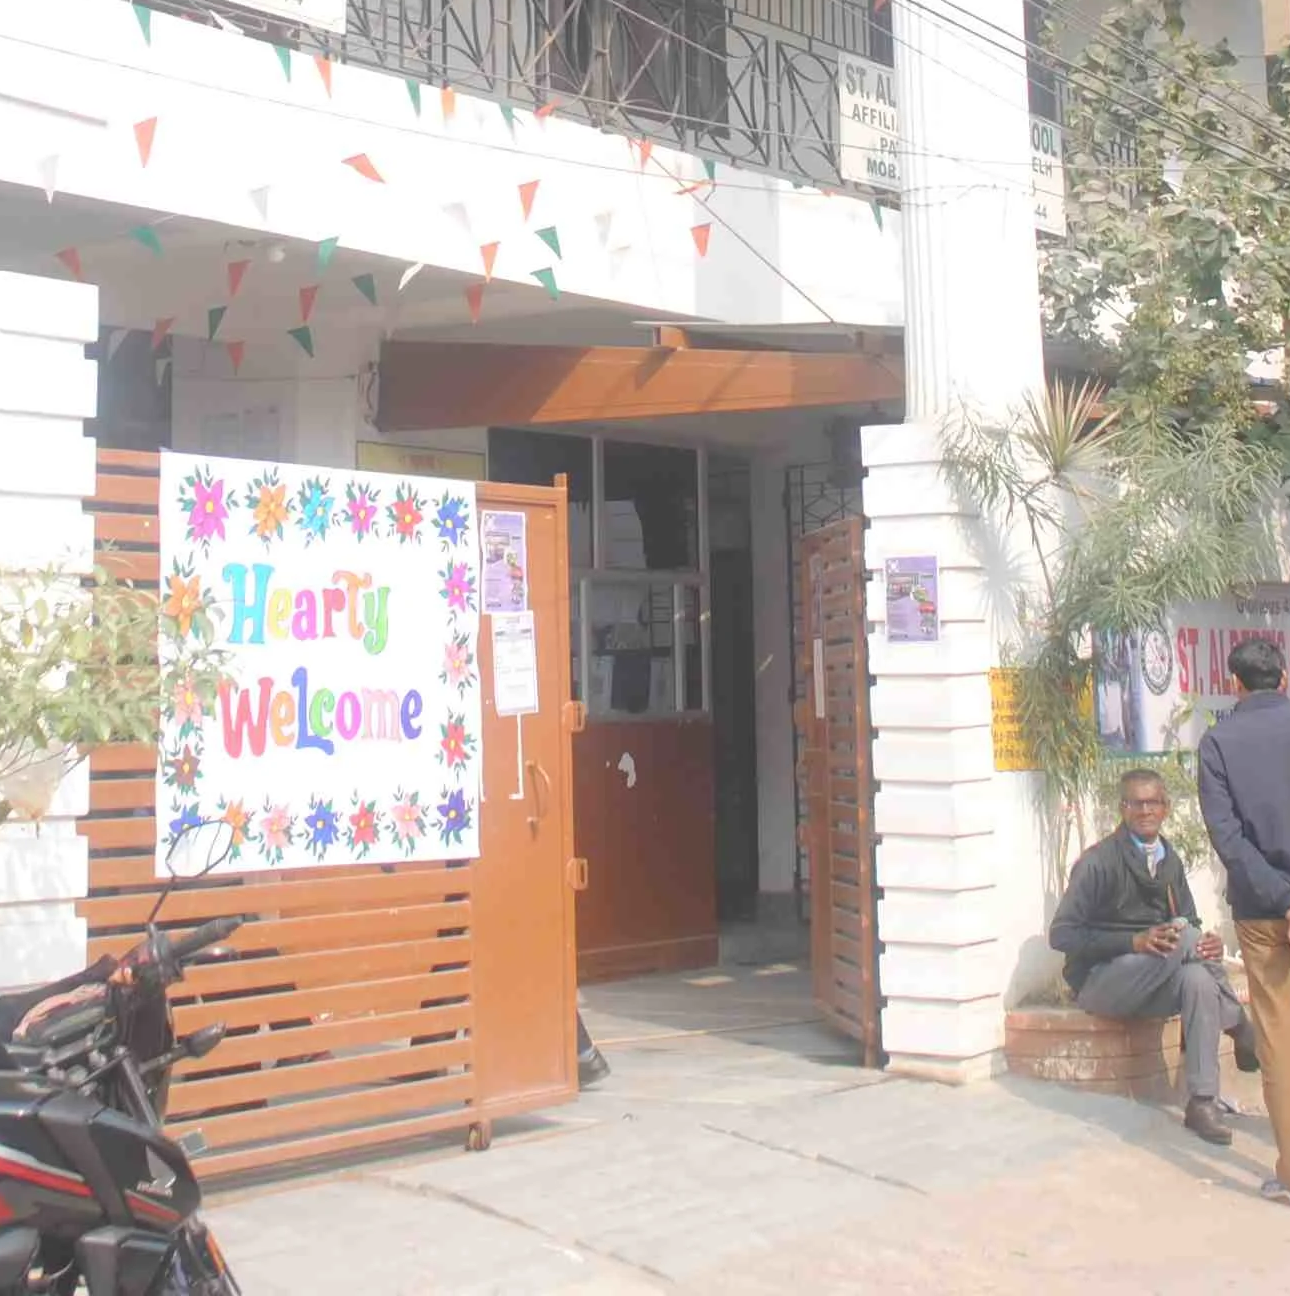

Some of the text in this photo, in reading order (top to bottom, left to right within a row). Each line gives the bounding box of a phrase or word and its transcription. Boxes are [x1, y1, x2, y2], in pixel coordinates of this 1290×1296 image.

[845, 62, 870, 100] ST.
[852, 103, 899, 133] AFFILI
[1032, 122, 1058, 158] OOL
